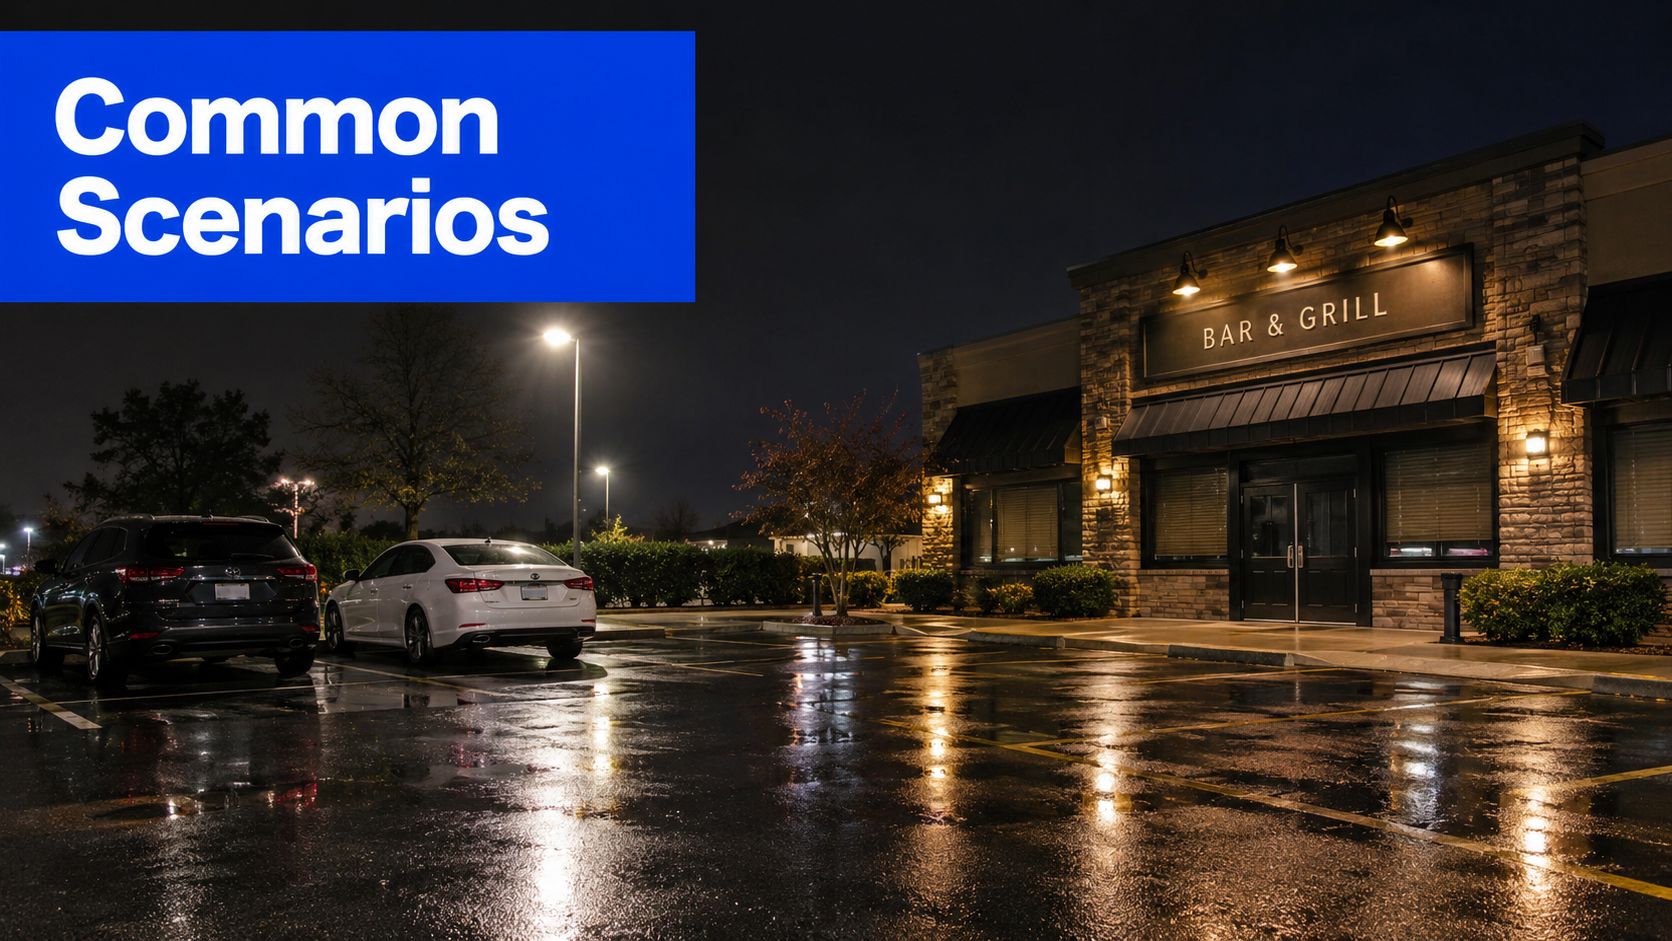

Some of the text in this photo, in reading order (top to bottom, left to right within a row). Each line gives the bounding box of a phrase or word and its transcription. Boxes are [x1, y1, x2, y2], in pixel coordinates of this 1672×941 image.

[1203, 292, 1388, 350] BAR & GRILL
